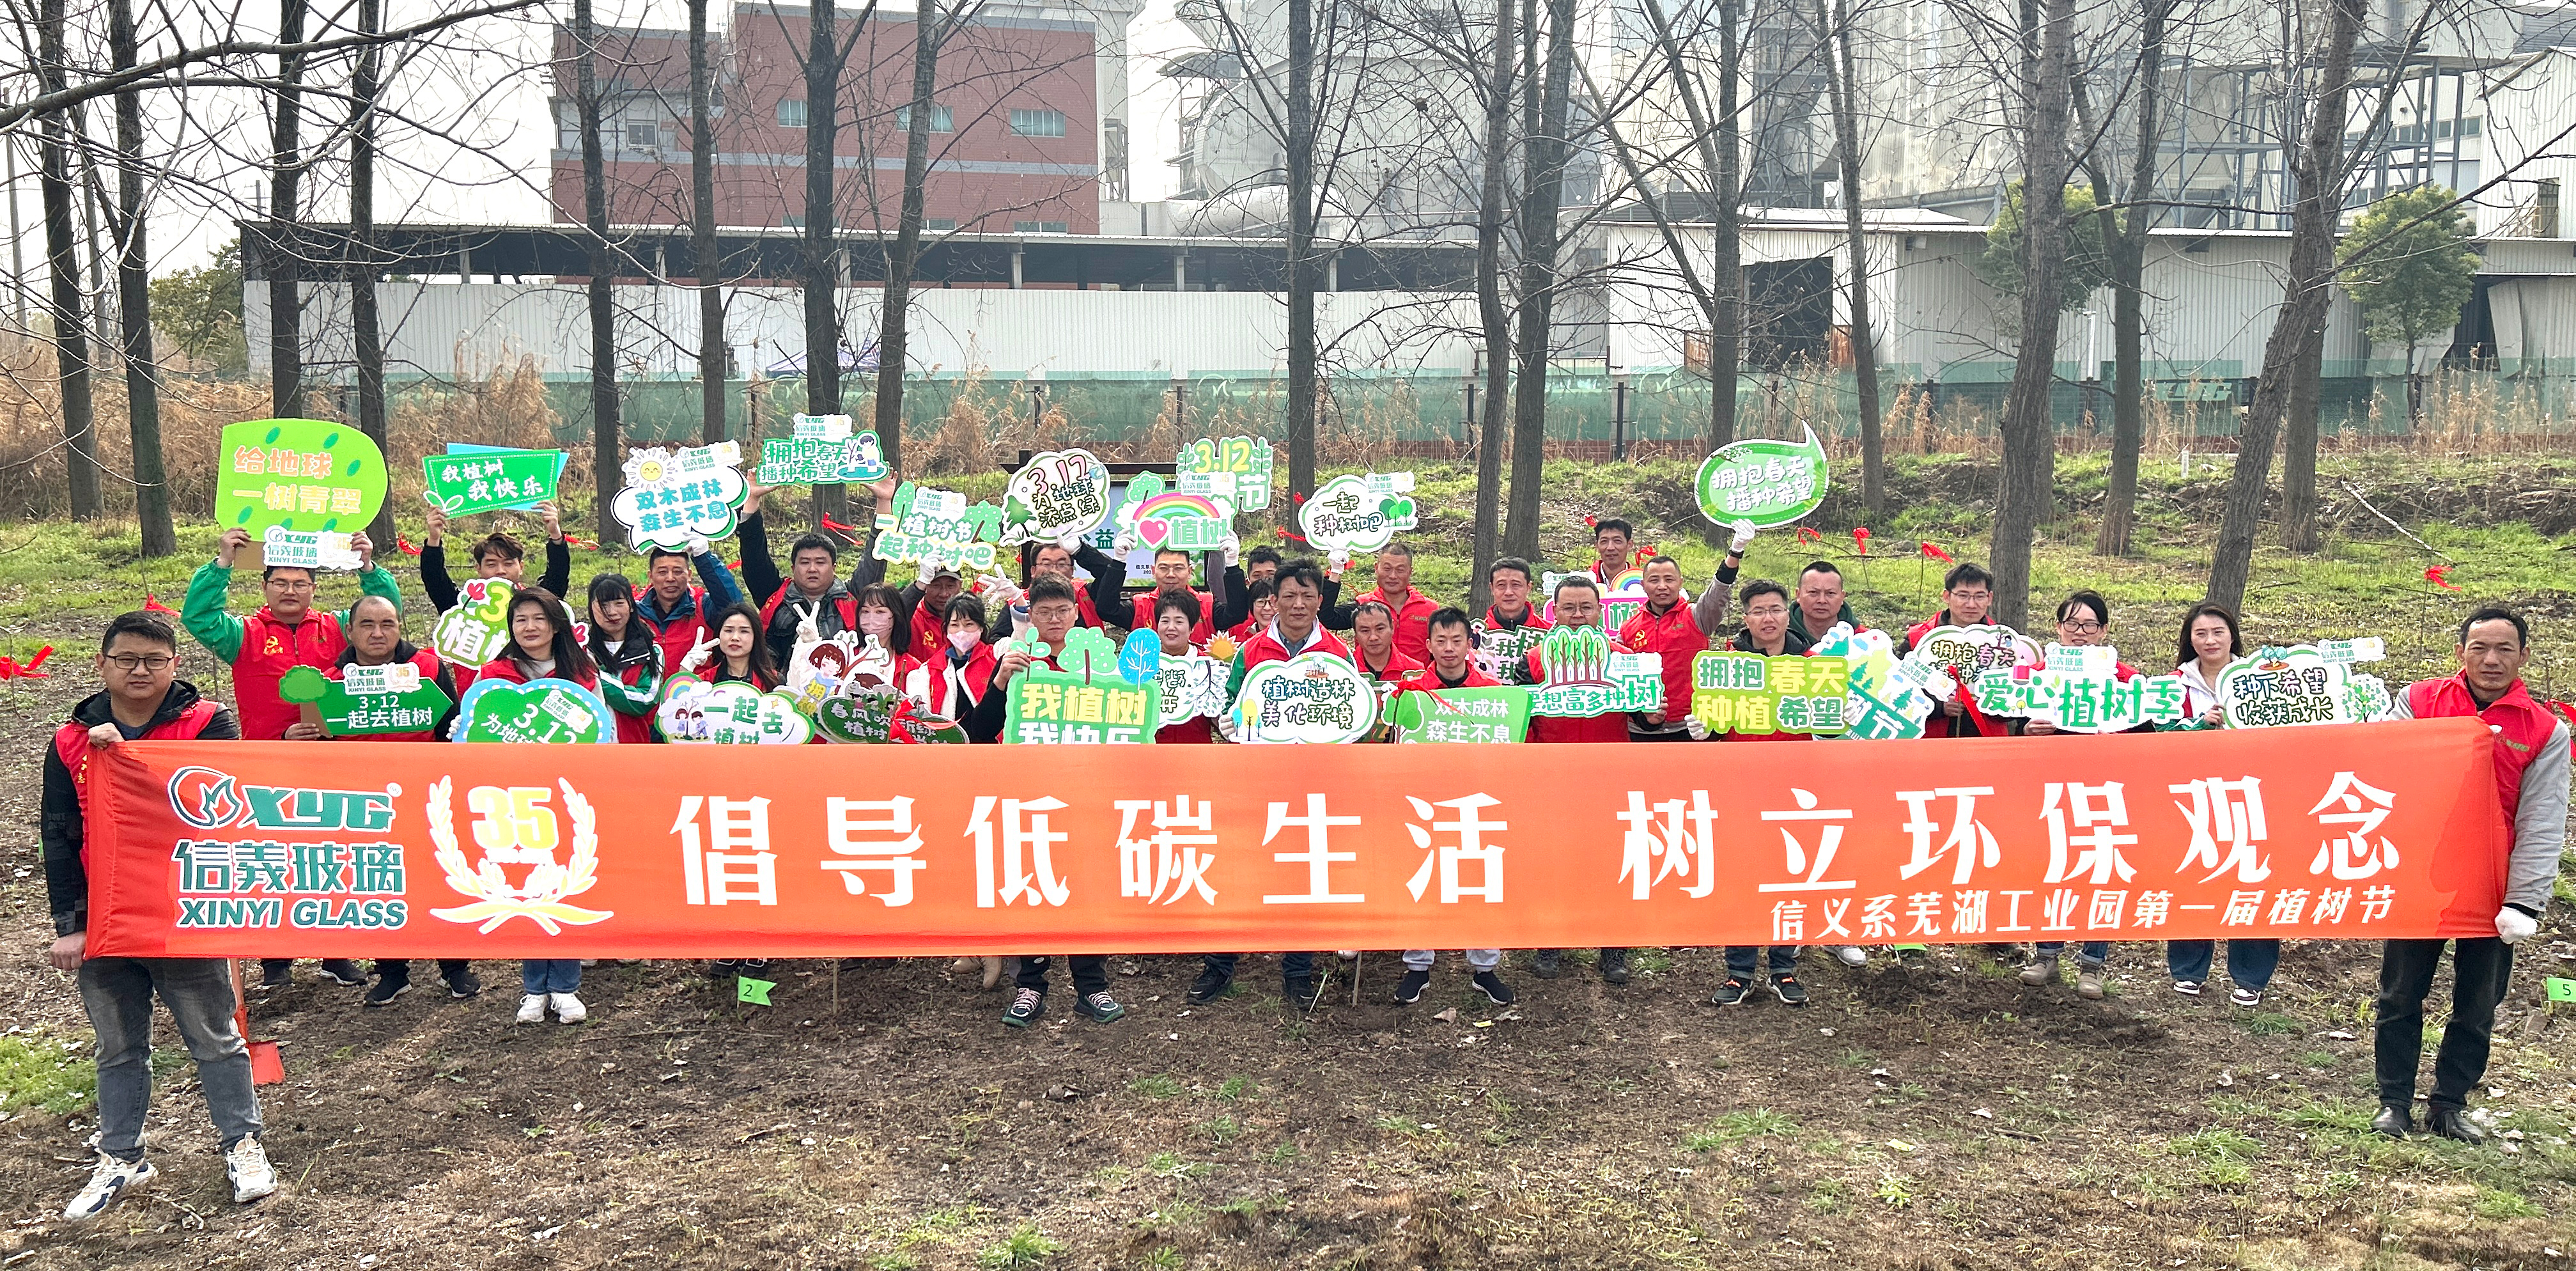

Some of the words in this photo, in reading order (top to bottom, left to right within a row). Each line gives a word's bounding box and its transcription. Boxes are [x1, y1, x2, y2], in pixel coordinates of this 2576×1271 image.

[235, 445, 333, 480] 给地球
[767, 438, 849, 464] 拥抱春天
[1195, 441, 1251, 473] 3.12
[441, 458, 504, 483] 我植树
[761, 458, 838, 480] 播种希望
[1027, 454, 1092, 494] 3.12
[1711, 455, 1806, 489] 拥抱春天
[233, 482, 362, 516] 一树青翠
[468, 474, 544, 502] 我快乐
[635, 478, 723, 511] 双木成林
[1032, 478, 1095, 510] 为地球
[1323, 491, 1360, 514] 一起
[1726, 475, 1813, 511] 播种希望
[639, 501, 728, 532] 森生不息
[1038, 494, 1100, 528] 添点绿
[1314, 511, 1384, 537] 种树吧
[1171, 519, 1228, 545] 植树
[1930, 639, 2016, 667] 拥抱春天
[1261, 675, 1356, 702] 植树造林
[1700, 658, 1845, 694] 拥抱春天
[2232, 667, 2327, 700] 种下希望
[704, 696, 783, 735] 一起去
[1020, 683, 1148, 726] 我植树
[1261, 699, 1354, 729] 美化环境
[1434, 698, 1509, 718] 双木成林
[1696, 694, 1843, 729] 种植希望
[1978, 672, 2182, 728] 爱心植树季
[2236, 696, 2334, 726] 收获成长
[327, 706, 433, 729] 一起去植树
[1425, 719, 1512, 744] 森生不息
[238, 784, 397, 832] XYG
[467, 785, 560, 850] 35
[669, 792, 1509, 908] 倡导低碳生活
[1617, 771, 2400, 900] 树立环保观念
[171, 839, 407, 896] 信義玻璃
[176, 898, 285, 930] XINYI
[290, 897, 409, 930] GLASS
[1770, 884, 2396, 942] 信义系芜湖工业园第一届植树节
[743, 984, 753, 997] 2
[2562, 983, 2572, 996] 5
